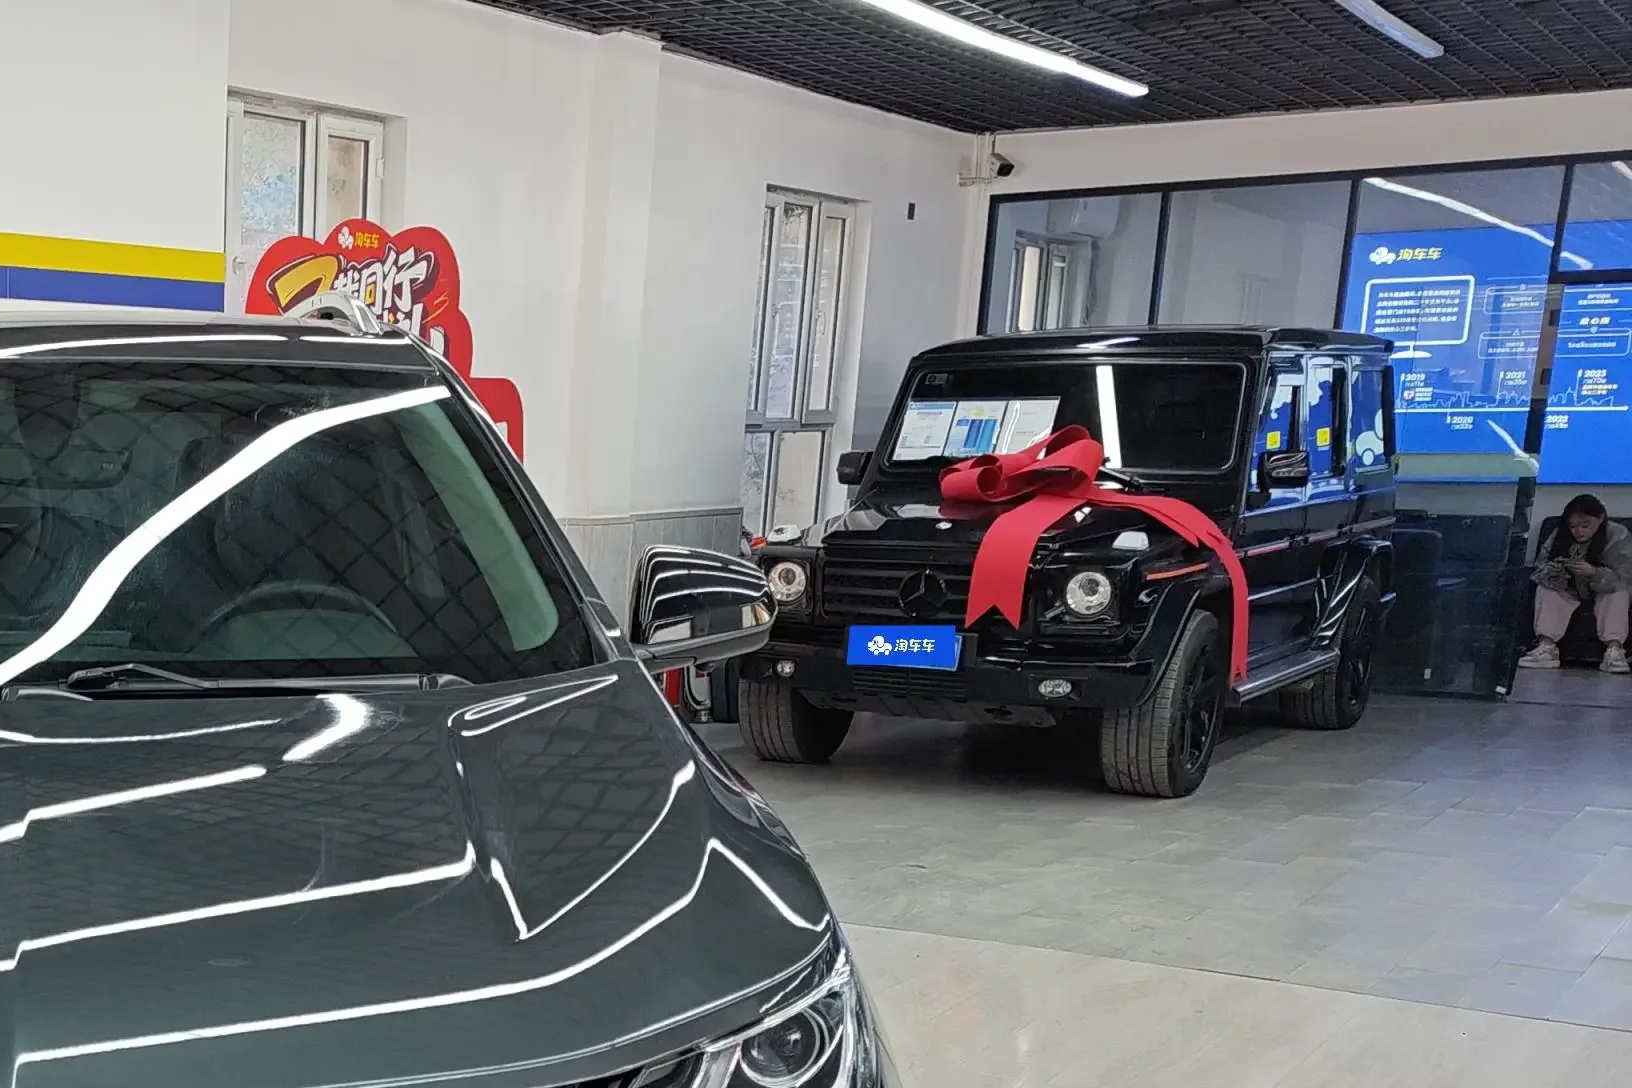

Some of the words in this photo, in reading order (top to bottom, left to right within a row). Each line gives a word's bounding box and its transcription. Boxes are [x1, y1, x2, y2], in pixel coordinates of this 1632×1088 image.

[1396, 247, 1443, 261] 淘车车
[894, 638, 936, 653] 淘车车
